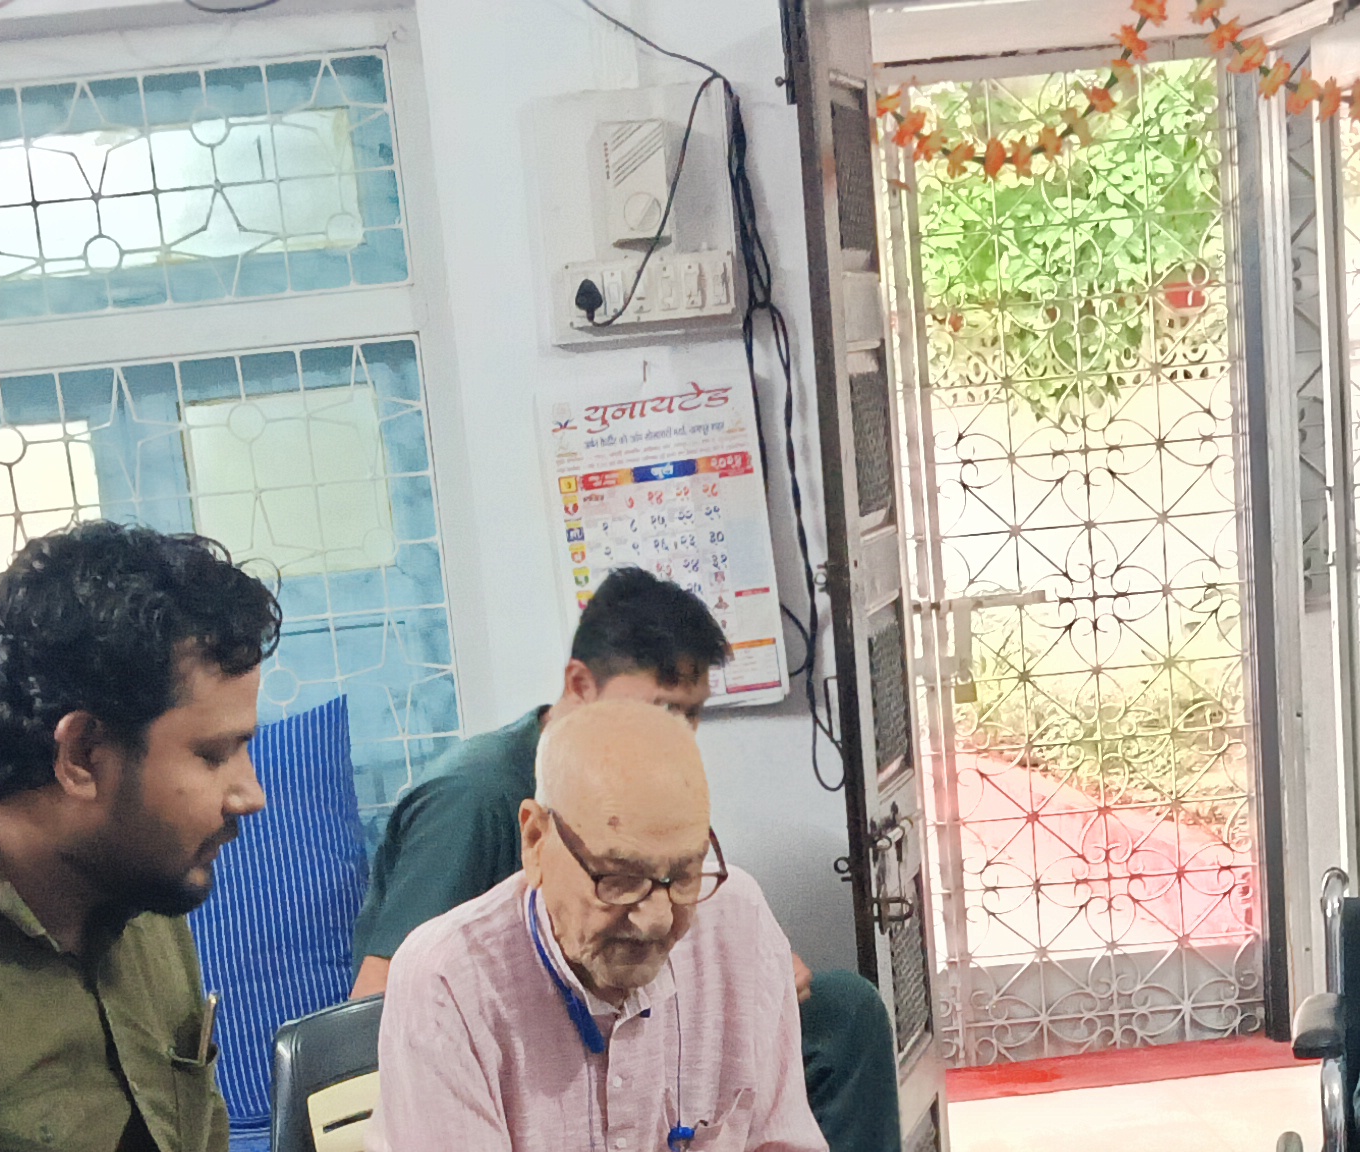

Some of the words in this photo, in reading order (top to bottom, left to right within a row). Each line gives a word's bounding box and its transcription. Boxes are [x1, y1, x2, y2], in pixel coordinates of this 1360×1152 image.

[584, 381, 732, 434] युनायटेड
[647, 490, 664, 505] १४
[702, 483, 719, 498] २८
[709, 531, 725, 546] ३०
